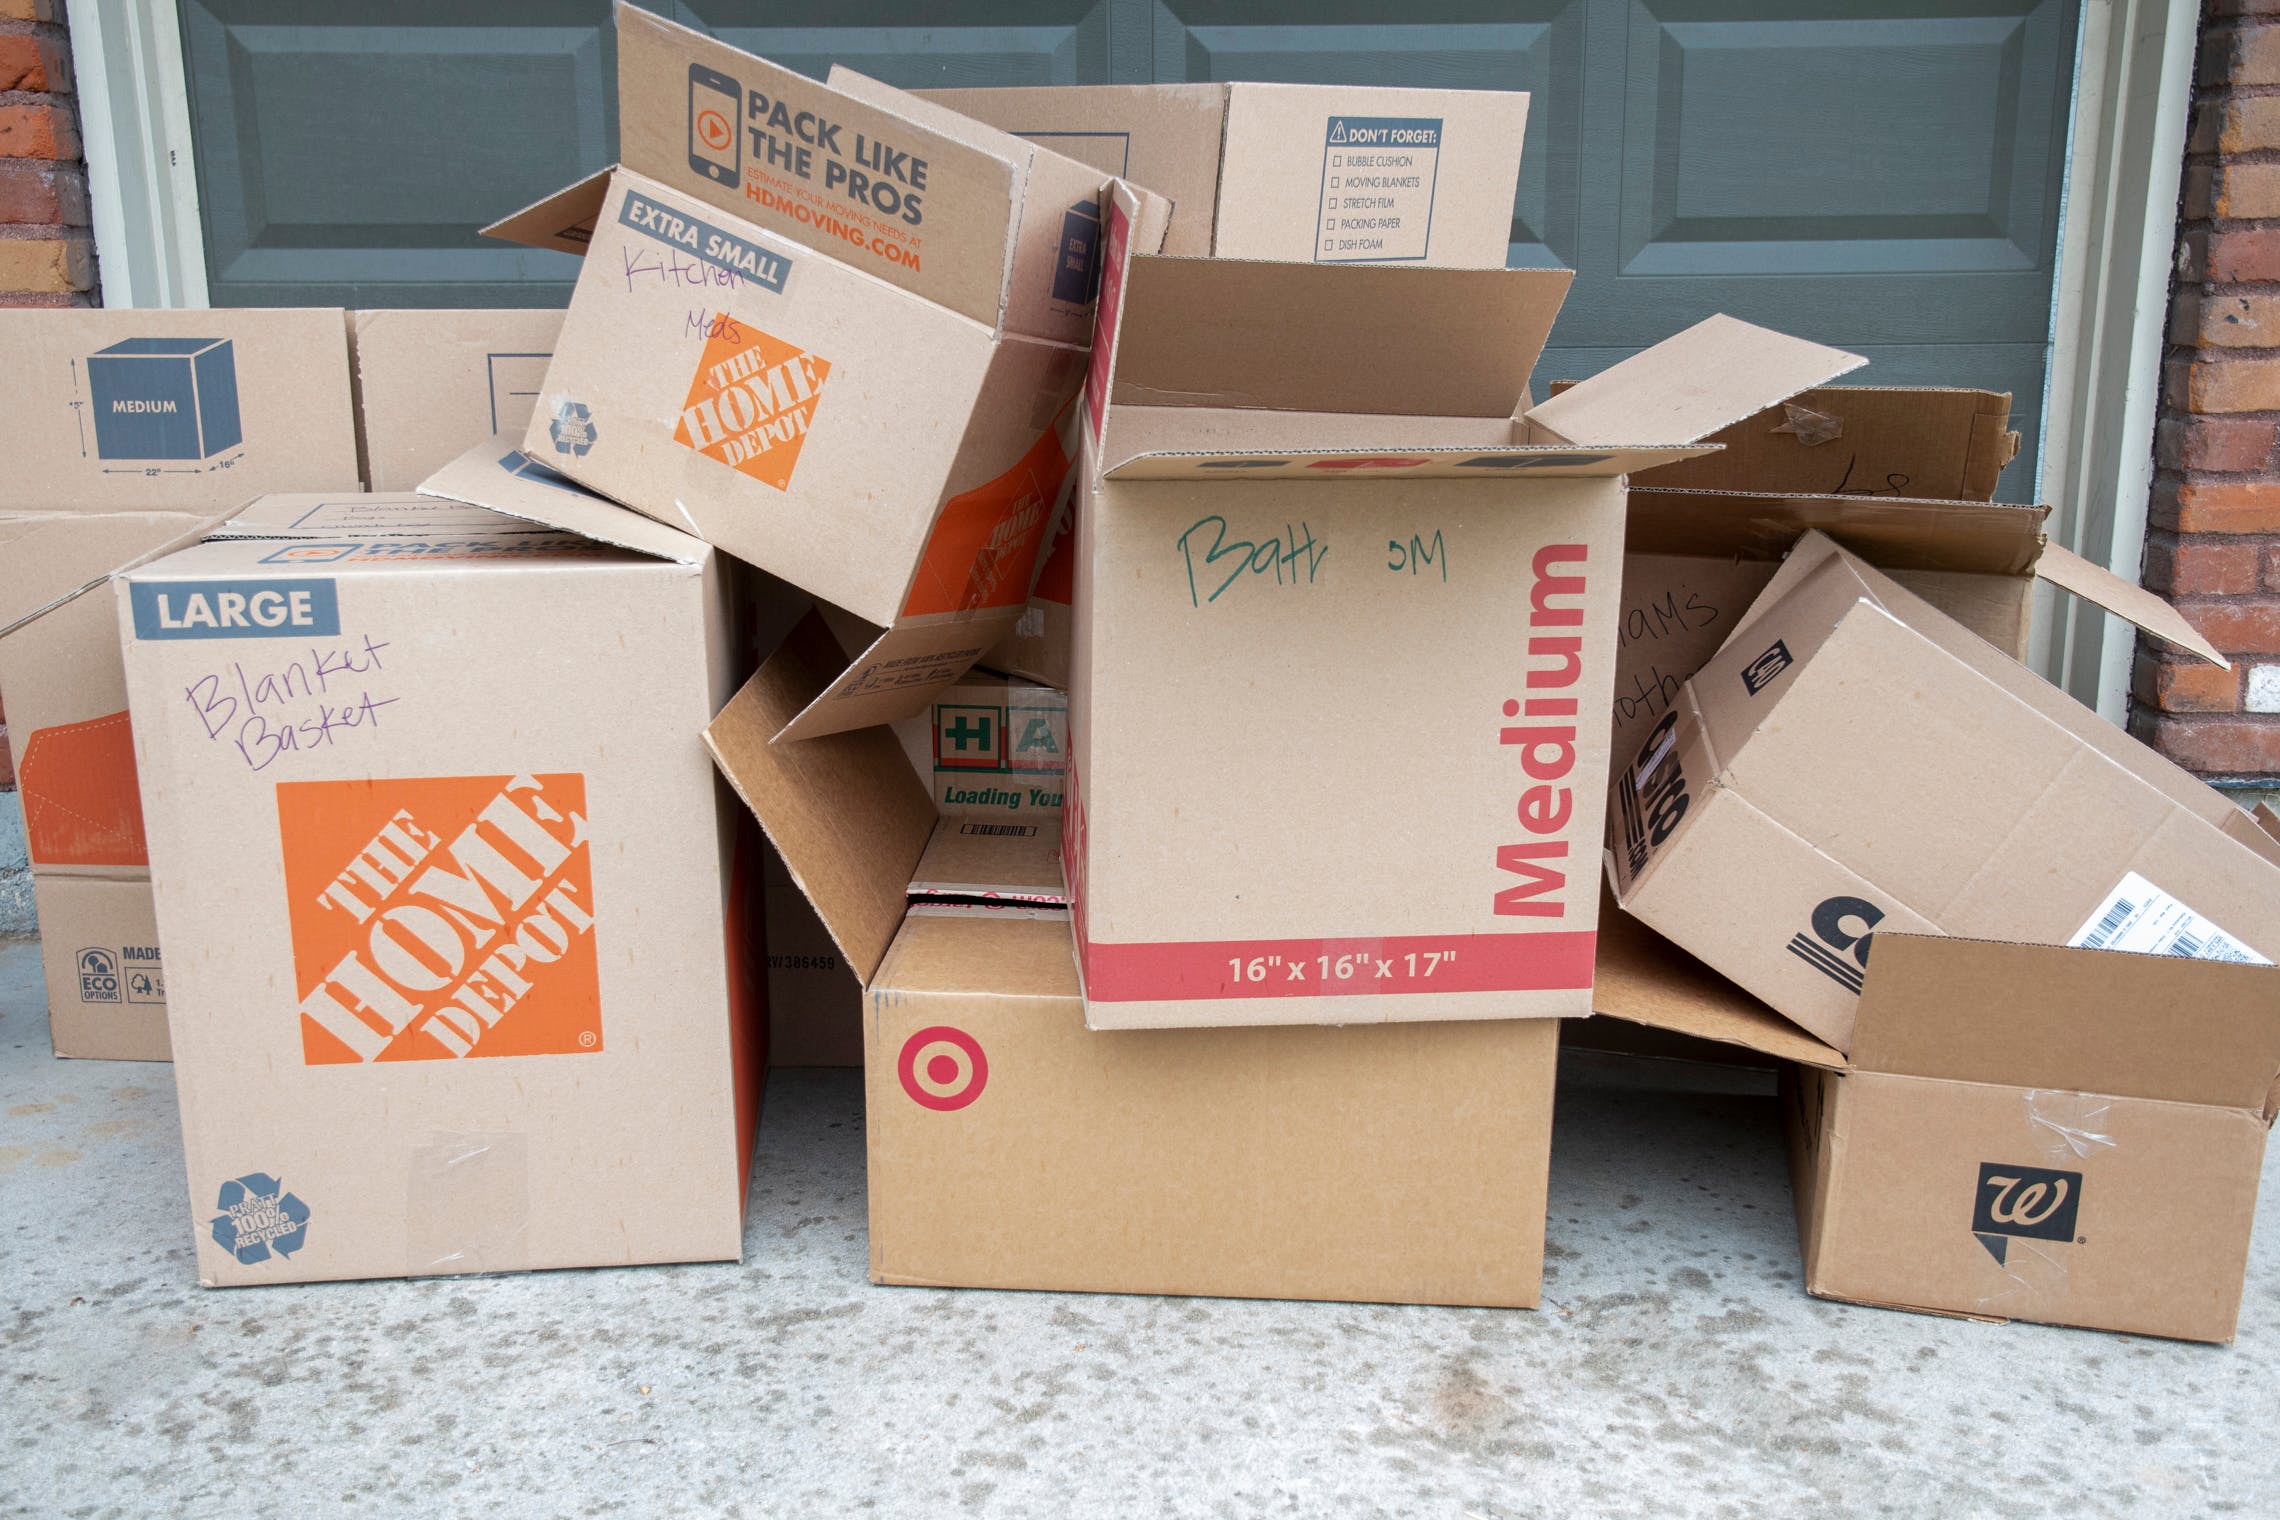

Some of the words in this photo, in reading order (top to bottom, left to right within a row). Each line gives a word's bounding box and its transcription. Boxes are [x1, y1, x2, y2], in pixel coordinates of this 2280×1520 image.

[749, 89, 843, 156] PACK
[856, 134, 929, 192] LIKE
[1350, 128, 1389, 143] DON'T
[1391, 129, 1437, 144] FORGET:
[748, 126, 812, 180] THE
[825, 159, 923, 226] PROS
[1347, 155, 1375, 168] BUBBLE
[1376, 155, 1413, 168] CUSHION
[1345, 176, 1381, 189] MOVING
[1381, 176, 1421, 189] BLANKETS
[747, 167, 793, 195] ESTIMATE
[796, 186, 824, 209] YOUR
[826, 199, 871, 228] MOVING
[873, 221, 907, 244] NEEDS
[908, 236, 923, 249] AT
[1343, 197, 1376, 209] STRETCH
[1377, 197, 1395, 208] FILM
[628, 200, 698, 249] EXTRA
[704, 234, 779, 285] SMALL
[746, 182, 921, 273] HDMOVING.COM
[1341, 218, 1376, 230] PACKING
[1378, 217, 1401, 229] PAPER
[1338, 239, 1358, 251] DISH
[1359, 238, 1383, 250] FOAM
[624, 245, 745, 293] Kitchen
[685, 308, 741, 345] Meds
[707, 345, 767, 392] THE
[112, 400, 177, 413] MEDIUM
[682, 353, 827, 451] HOME
[721, 406, 808, 467] DEPOT
[145, 468, 162, 476] 22"
[158, 590, 314, 629] LARGE
[185, 634, 390, 741] Blanket
[235, 691, 400, 771] Basket
[1493, 544, 1588, 919] Medium
[1638, 710, 1690, 847] CSTCO
[944, 787, 1022, 810] Loading
[316, 808, 443, 925] THE
[299, 773, 589, 1063] HOME
[123, 946, 161, 960] MADE
[420, 878, 595, 1059] DEPOT
[1229, 955, 1282, 983] 16"
[1287, 961, 1306, 981] x
[1317, 953, 1369, 980] 16"
[1374, 959, 1393, 978] x
[1404, 950, 1456, 978] 17"
[83, 977, 117, 991] ECO
[84, 991, 118, 1000] OPTIONS
[229, 1193, 280, 1218] PRATT
[231, 1205, 290, 1236] 100%
[235, 1221, 297, 1249] RECYCLED
